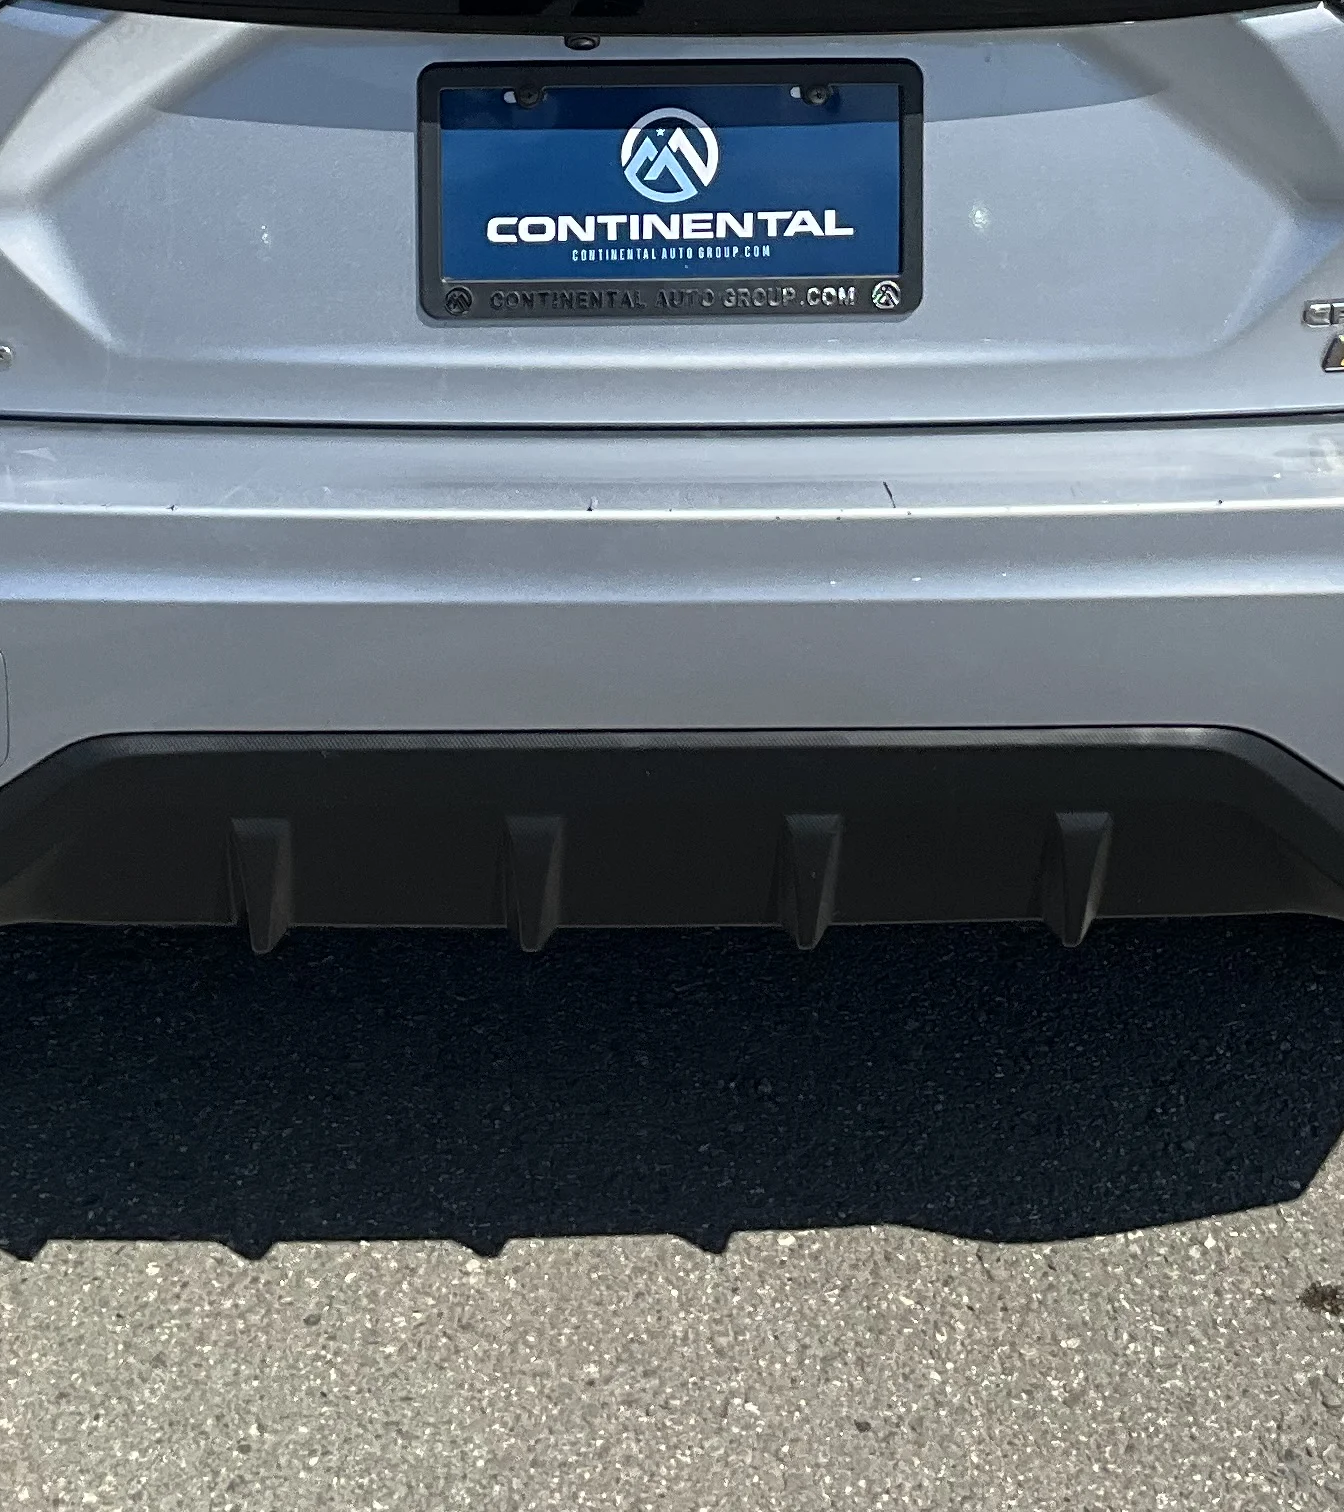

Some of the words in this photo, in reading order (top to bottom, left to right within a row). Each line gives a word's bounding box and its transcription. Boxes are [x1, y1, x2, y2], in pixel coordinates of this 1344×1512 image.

[486, 209, 854, 243] CONTINENTAL
[572, 246, 657, 262] CONTINENTAL
[661, 246, 693, 260] AUTO
[489, 289, 647, 311] CONTINENTAL
[656, 288, 715, 309] AUTO
